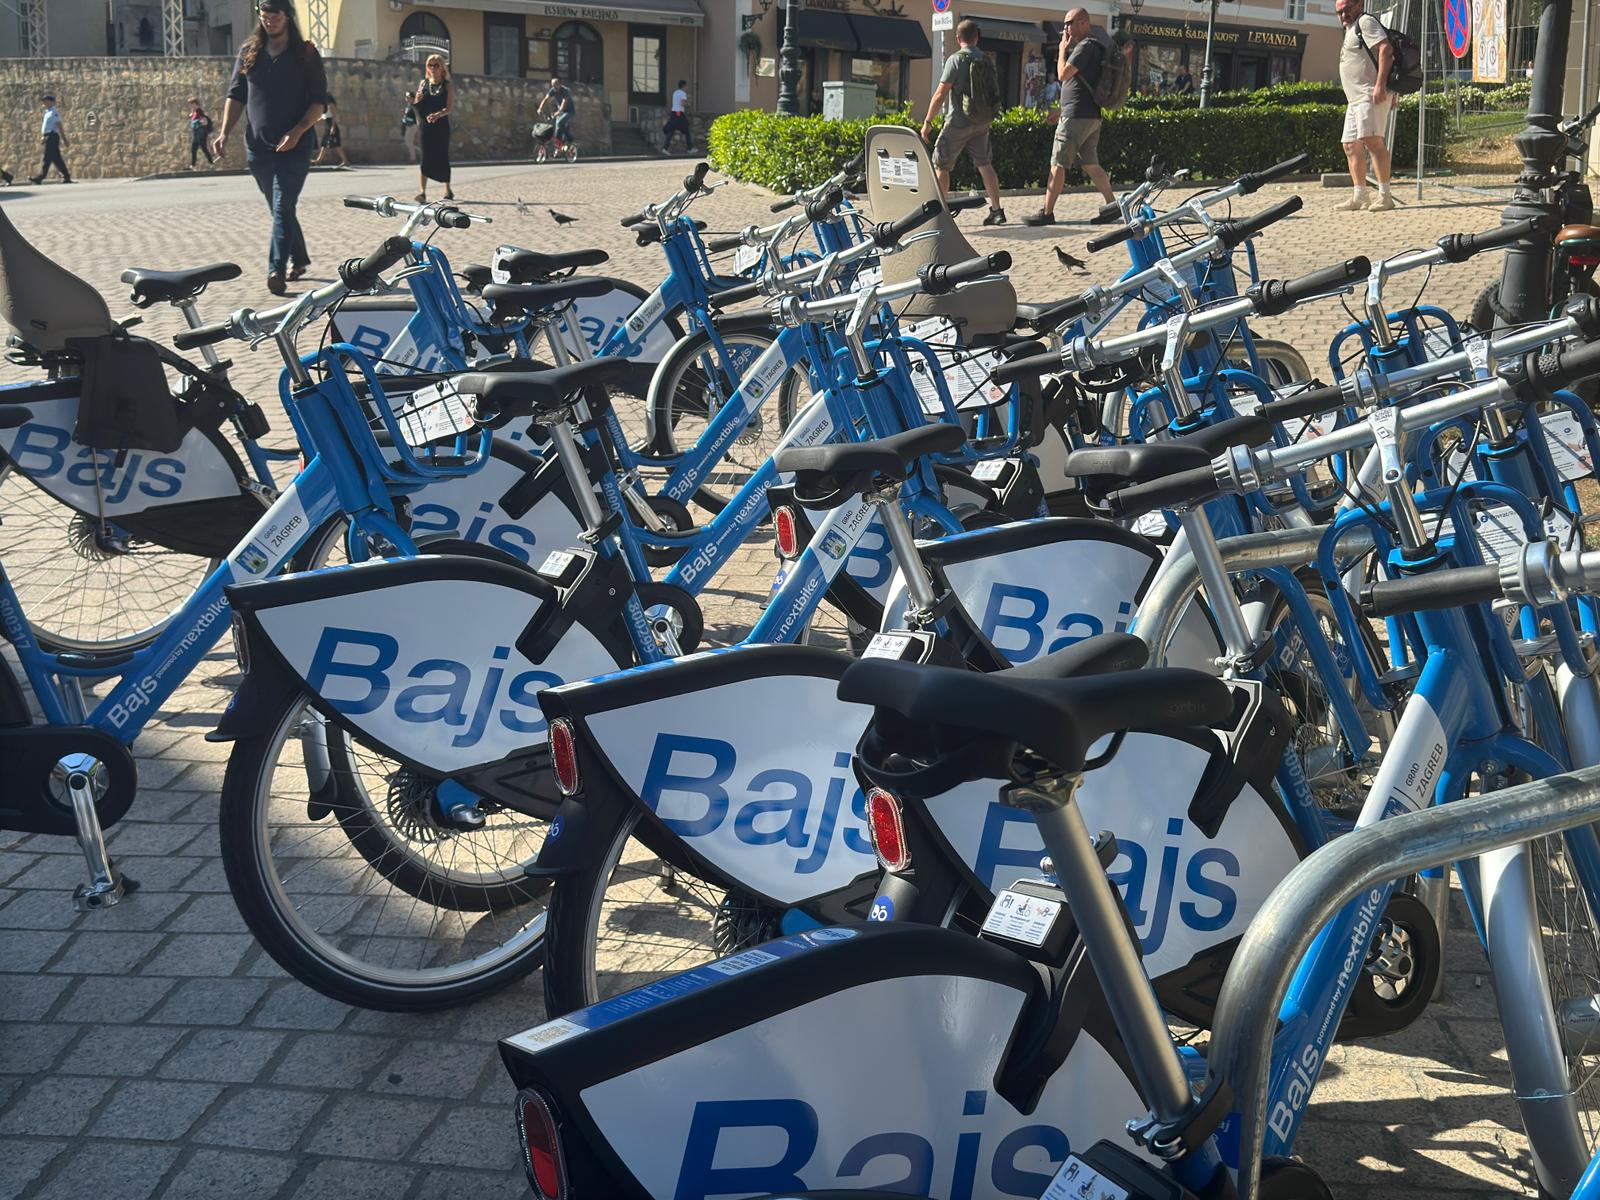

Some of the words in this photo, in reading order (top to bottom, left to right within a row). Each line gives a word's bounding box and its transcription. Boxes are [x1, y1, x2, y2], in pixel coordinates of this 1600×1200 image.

[1185, 28, 1239, 43] SADANJOST
[1248, 31, 1298, 47] LEVANDA
[766, 360, 784, 381] ZAGREB
[667, 468, 698, 501] Bajs
[710, 416, 740, 453] nextbike
[805, 420, 829, 446] ZAGREB
[11, 423, 186, 503] Bajs
[263, 524, 278, 540] GRAD
[271, 514, 303, 549] ZAGREB
[680, 541, 718, 585] Bajs
[734, 480, 772, 525] nextbike
[841, 510, 853, 525] GRAD
[628, 602, 656, 653] 800299
[780, 577, 819, 635] nextbike
[106, 675, 158, 729] Bajs
[156, 655, 178, 680] powered
[174, 647, 185, 661] by
[181, 595, 230, 651] nextbike
[1405, 762, 1420, 787] GRAD
[1415, 743, 1444, 798] ZAGREB
[1268, 1044, 1319, 1144] Bajs
[1317, 1000, 1336, 1046] powered
[1332, 989, 1342, 1004] by
[1337, 888, 1382, 990] nextbike
